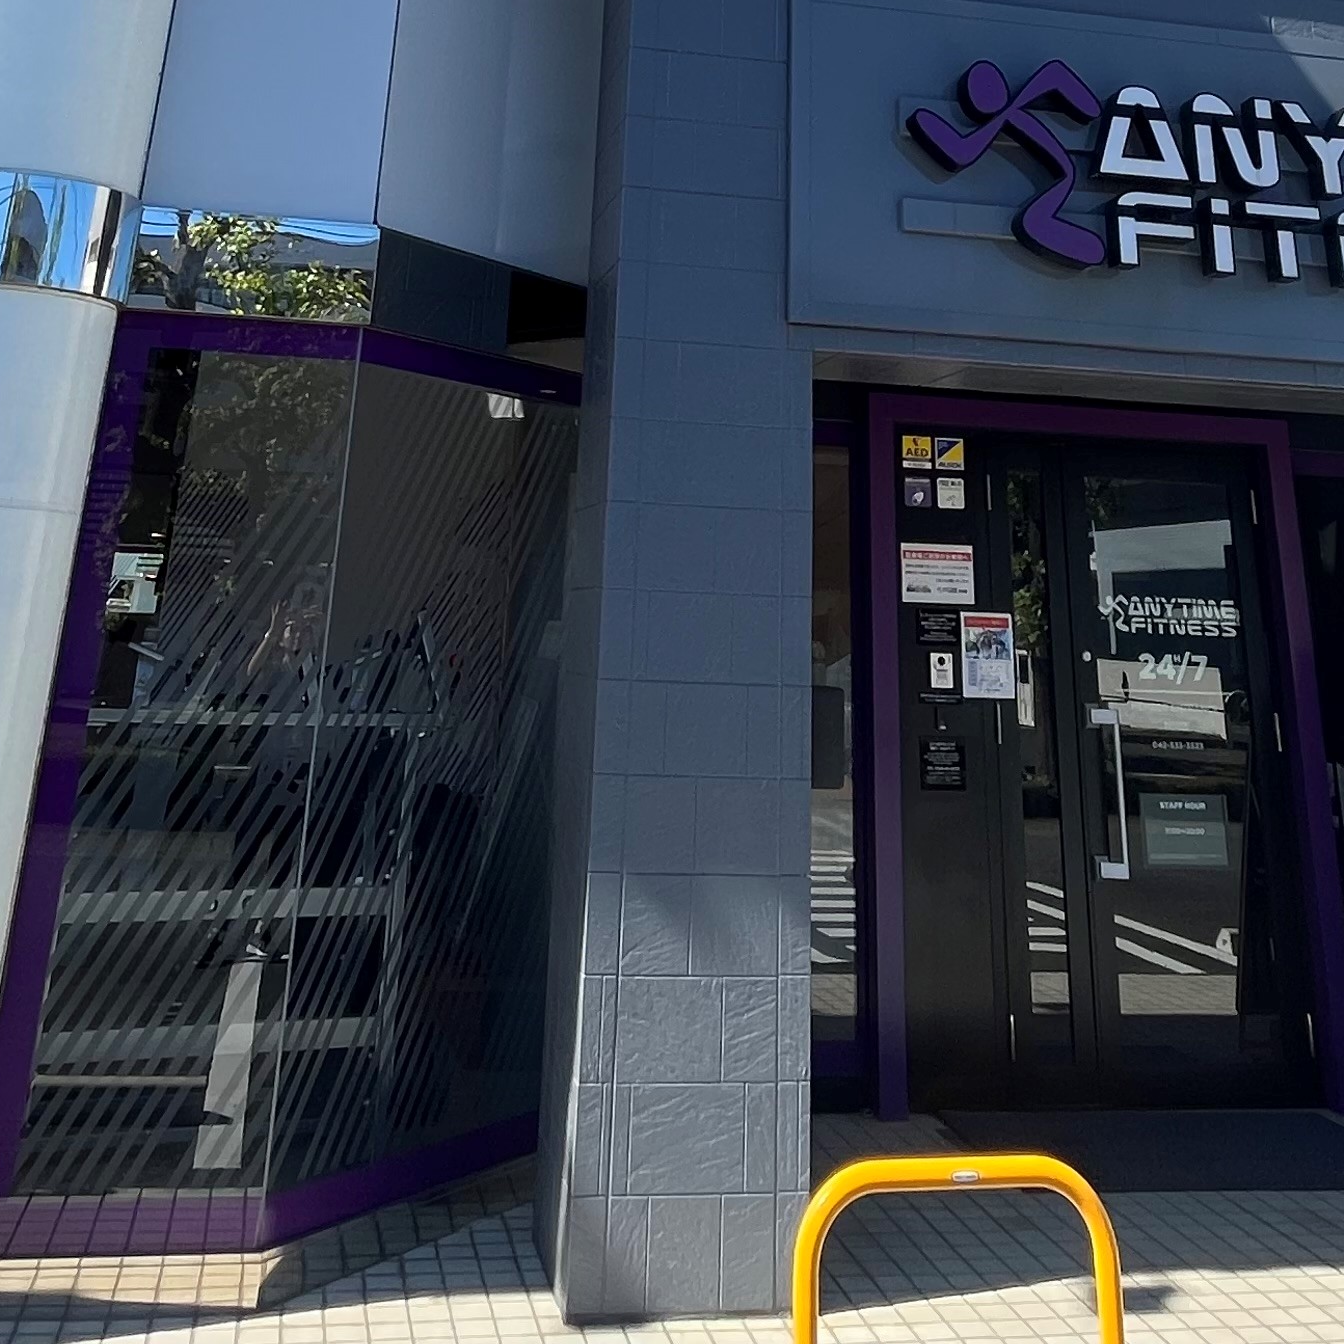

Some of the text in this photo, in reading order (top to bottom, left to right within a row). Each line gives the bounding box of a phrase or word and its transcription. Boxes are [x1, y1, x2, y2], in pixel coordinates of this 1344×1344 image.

[905, 447, 929, 457] AED
[1128, 596, 1237, 619] ANYTIME
[1131, 618, 1238, 637] FITNESS
